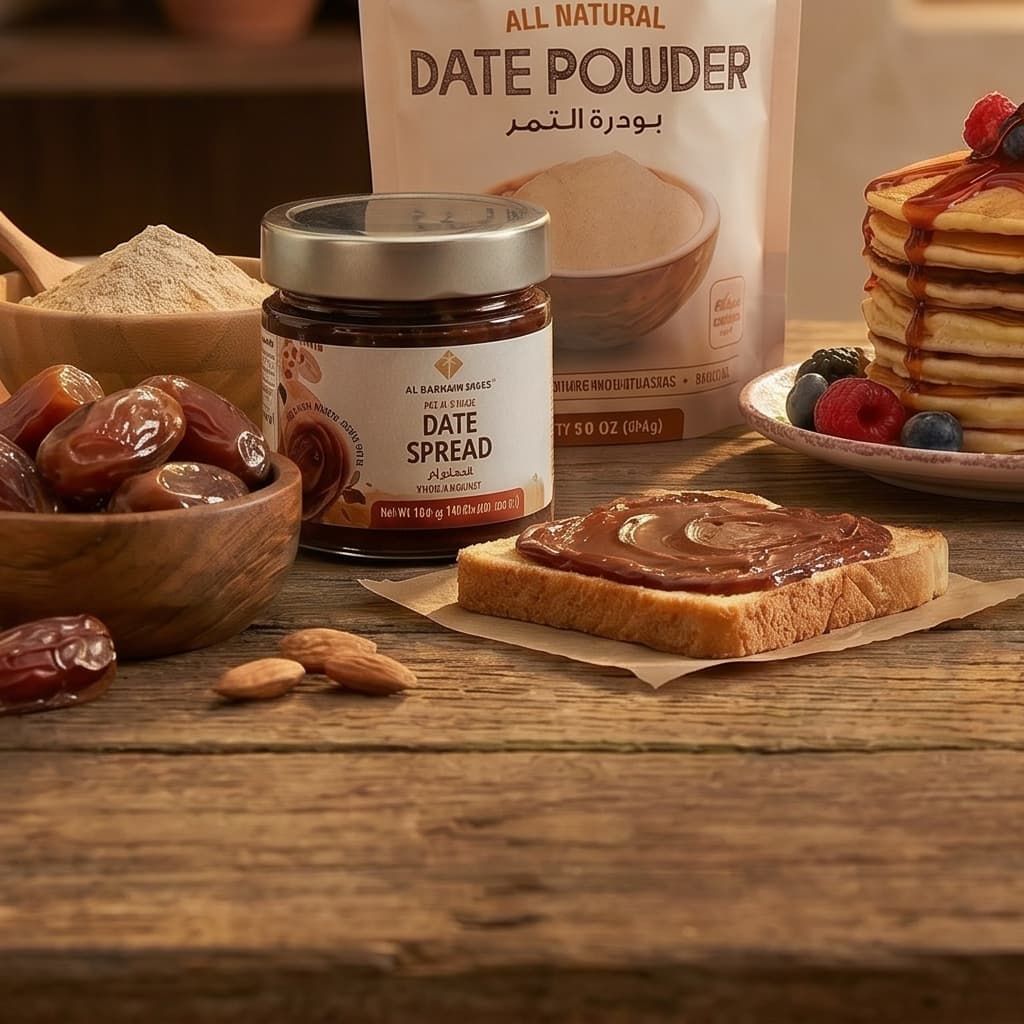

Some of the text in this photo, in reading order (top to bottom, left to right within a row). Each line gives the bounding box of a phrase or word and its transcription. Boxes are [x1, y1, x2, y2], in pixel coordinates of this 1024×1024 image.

[504, 1, 667, 33] ALL NATURAL
[409, 44, 752, 97] DATE POWDER
[505, 107, 663, 137] بودرة التمر
[422, 411, 478, 437] DATE
[405, 436, 493, 464] SPREAD
